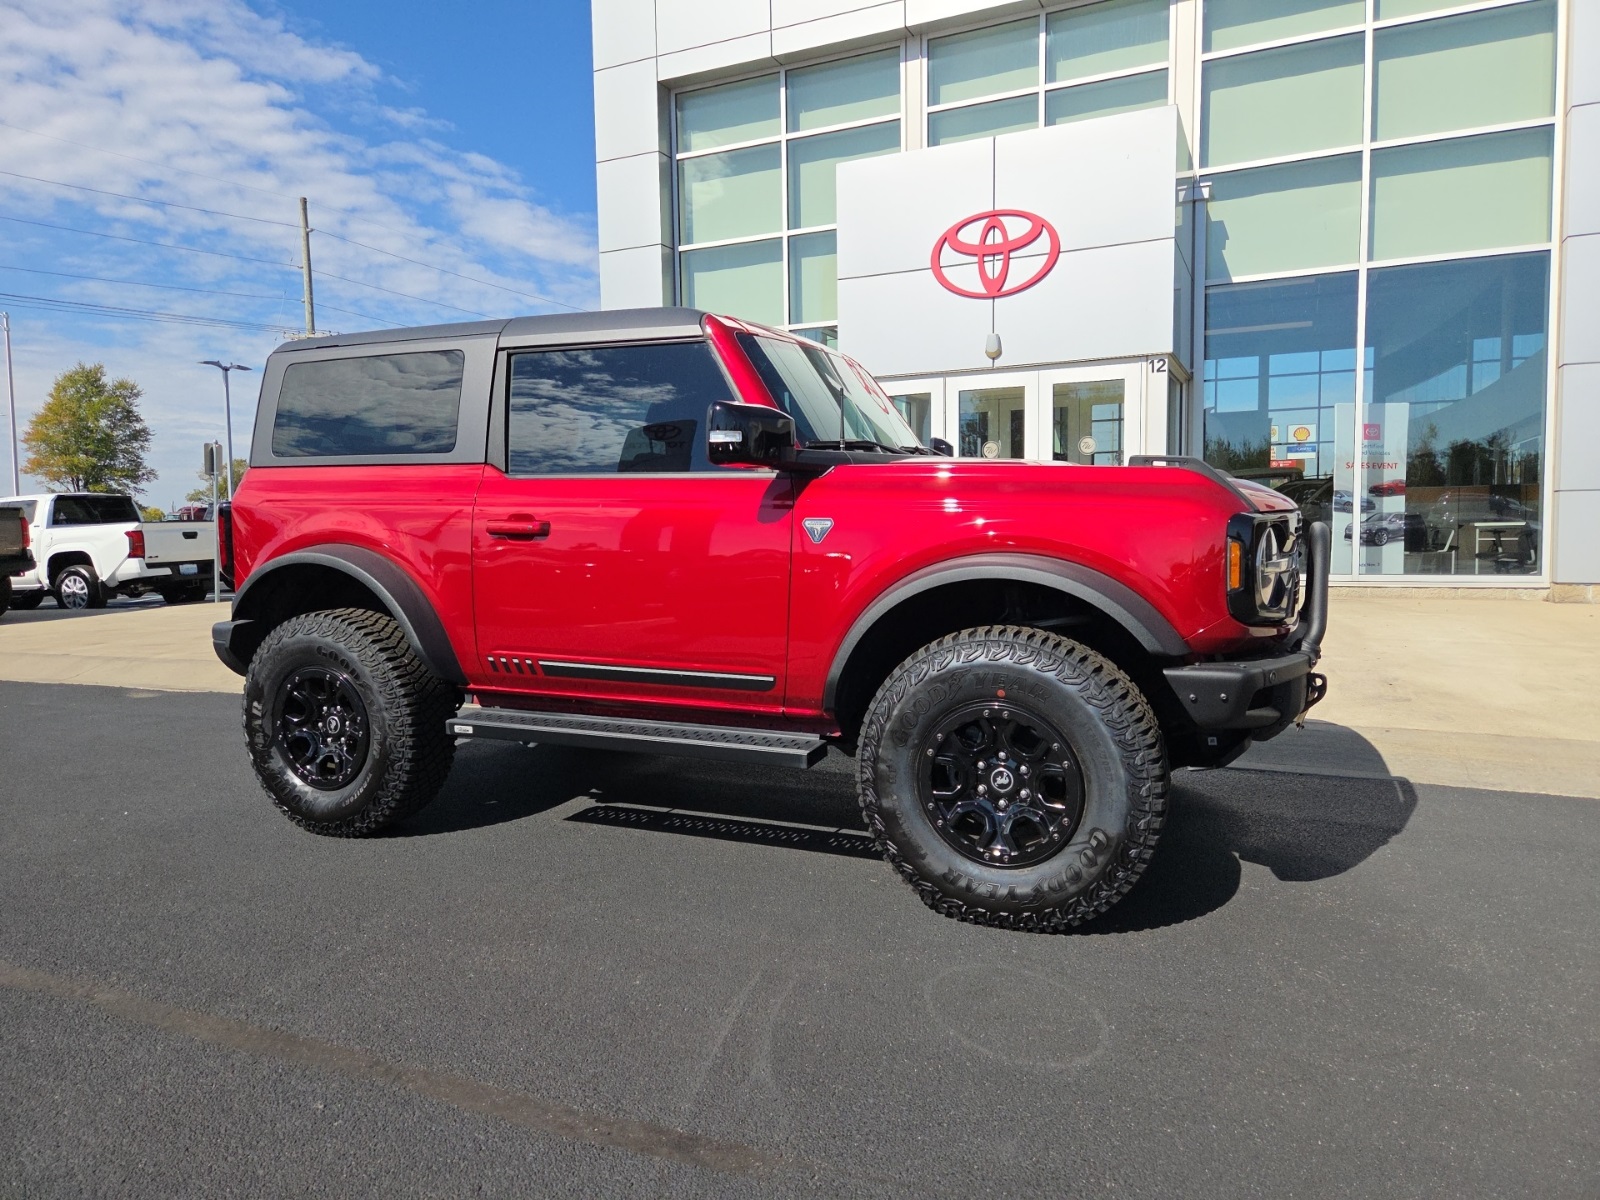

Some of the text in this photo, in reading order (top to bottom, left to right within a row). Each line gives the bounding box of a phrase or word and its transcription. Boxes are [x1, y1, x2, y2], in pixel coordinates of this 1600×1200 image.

[1148, 358, 1167, 374] 12
[1346, 461, 1398, 470] SAES EVENT
